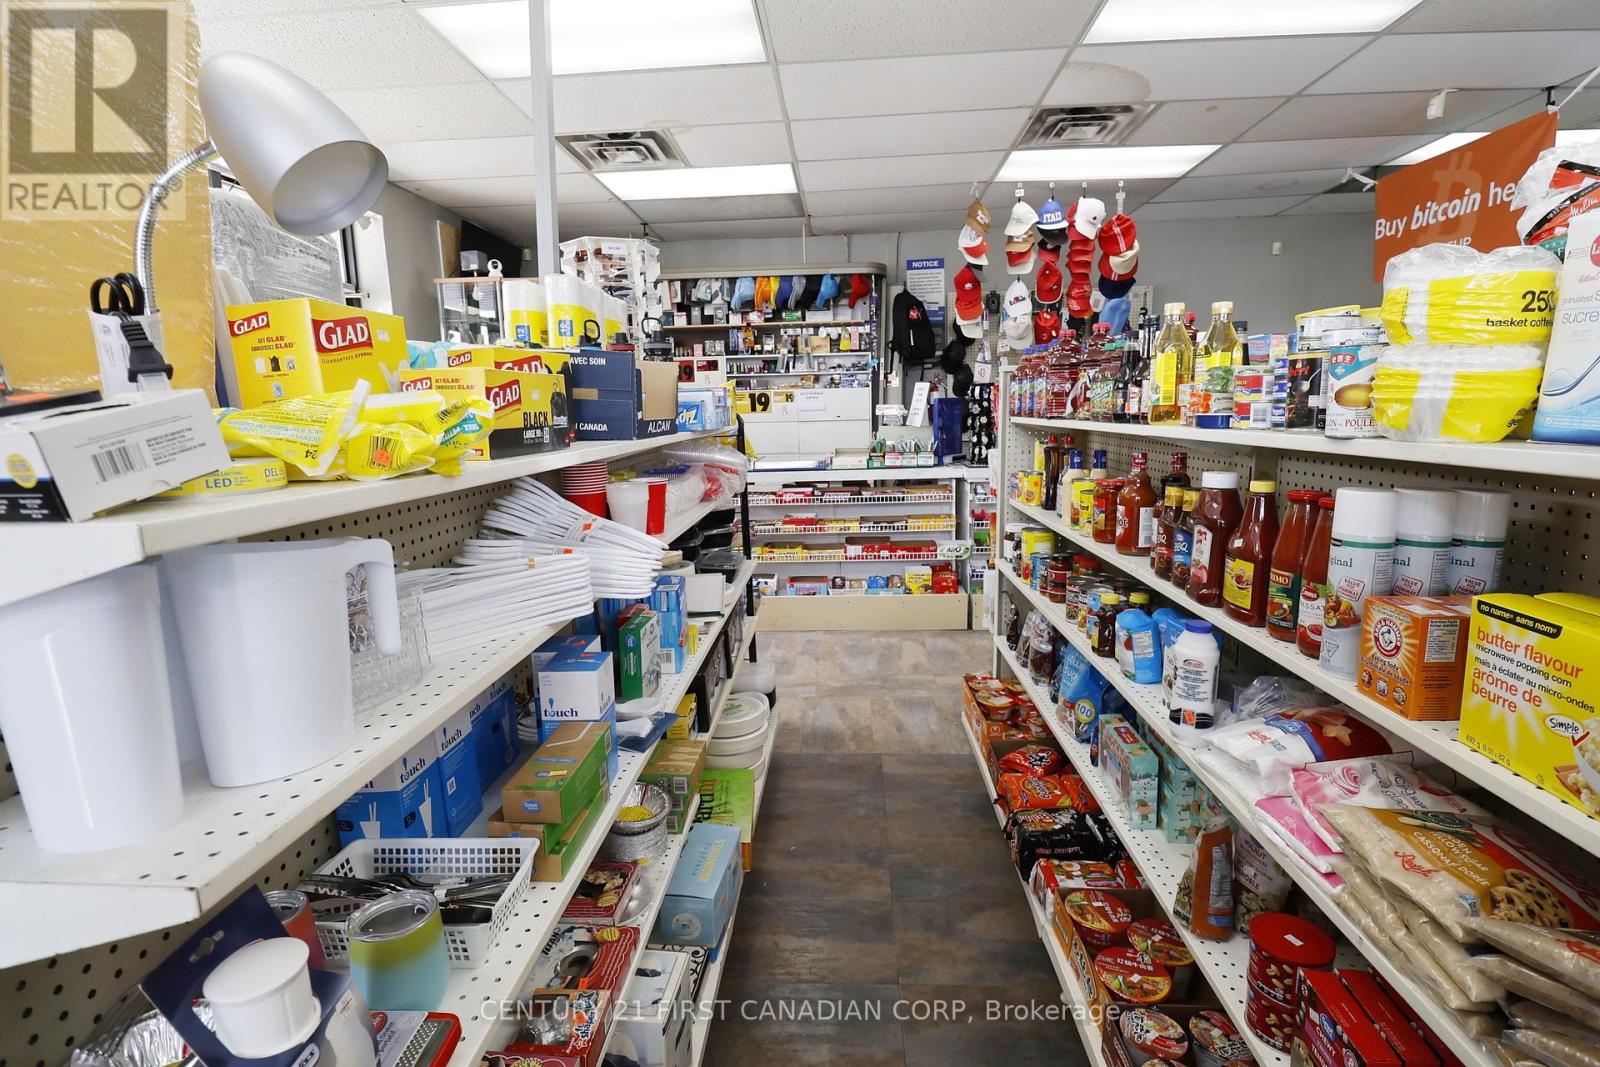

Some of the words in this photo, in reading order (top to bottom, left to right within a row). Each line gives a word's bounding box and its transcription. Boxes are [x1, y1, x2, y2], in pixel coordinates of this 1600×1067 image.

[1375, 216, 1407, 240] Buy
[1410, 188, 1482, 230] bitcoin
[1488, 181, 1517, 207] he
[912, 260, 939, 268] NOTICE
[233, 313, 268, 335] GLAD
[1486, 318, 1528, 327] basket
[319, 321, 369, 350] GLAD
[449, 352, 471, 367] GLAD
[570, 357, 588, 365] AVEC
[589, 357, 606, 365] SOIN
[490, 384, 520, 409] GLAD
[749, 392, 770, 412] 19
[785, 391, 794, 403] 19
[523, 411, 549, 427] BLACK
[579, 422, 608, 432] CANADA
[647, 421, 671, 433] ALCAN
[1345, 418, 1376, 427] POULE
[523, 429, 536, 439] LARGE
[304, 449, 318, 459] 24
[205, 478, 232, 489] LED
[264, 467, 280, 478] DEL
[1479, 603, 1489, 612] no
[1515, 614, 1534, 627] sans
[1477, 625, 1521, 654] butter
[1523, 643, 1584, 680] flavour
[1475, 643, 1515, 665] microwave
[1515, 658, 1550, 682] popping
[1551, 673, 1572, 688] corn
[1473, 664, 1519, 697] arôme
[1522, 687, 1543, 708] de
[1491, 662, 1497, 673] à
[1497, 664, 1524, 683] éclater
[1525, 677, 1536, 688] au
[1537, 679, 1596, 714] micro-ondes
[1471, 679, 1518, 714] beurre
[469, 704, 481, 718] uch
[544, 708, 578, 718] touch
[1077, 703, 1093, 718] 100
[1549, 717, 1580, 735] Simple
[441, 728, 462, 751] touch
[400, 757, 426, 784] touch
